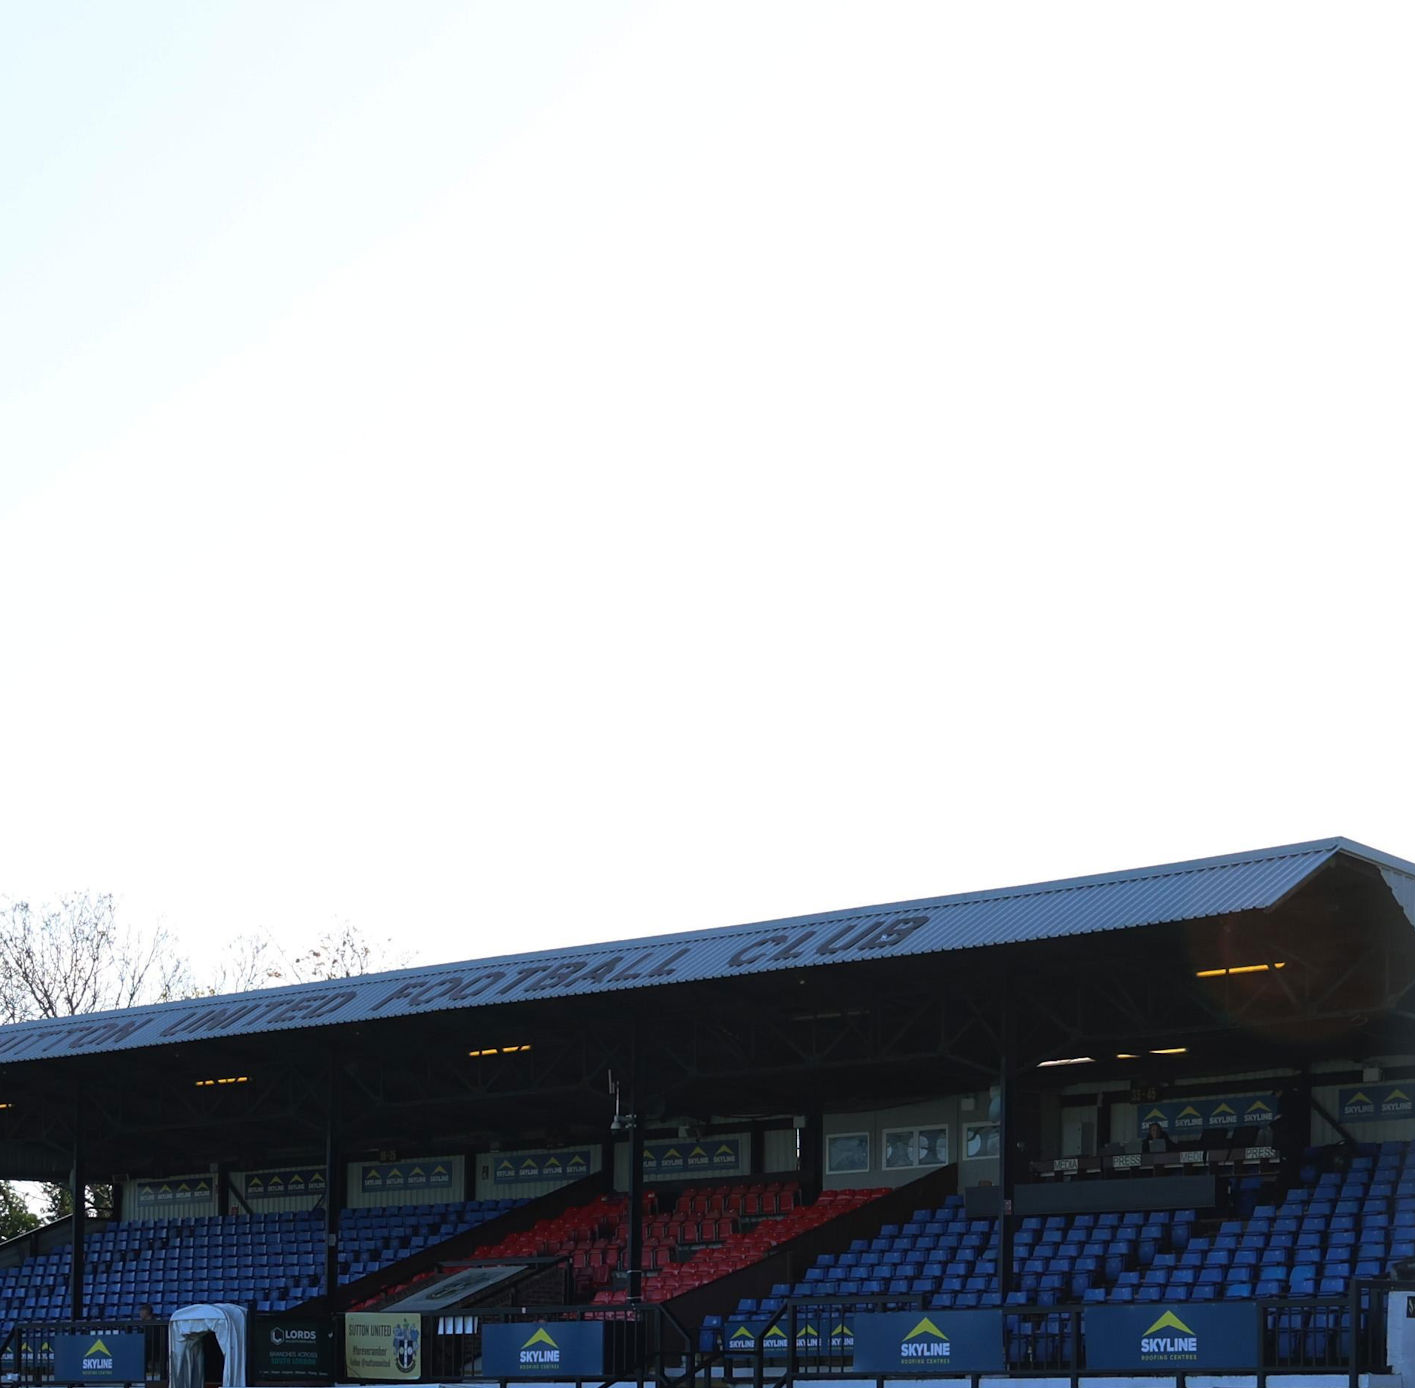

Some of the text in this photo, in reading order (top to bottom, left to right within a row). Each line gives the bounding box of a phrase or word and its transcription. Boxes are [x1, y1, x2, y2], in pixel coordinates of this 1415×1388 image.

[159, 991, 357, 1037] UNITED
[372, 946, 689, 1011] FOOTBALL
[728, 915, 931, 969] CLUB
[285, 1329, 316, 1340] LORDS
[349, 1325, 392, 1336] SUTTON UNITED
[901, 1343, 950, 1356] SKYLINE
[1141, 1337, 1197, 1352] SKYLINE
[520, 1351, 560, 1363] SKYLINE
[82, 1358, 112, 1369] SKYLINE
